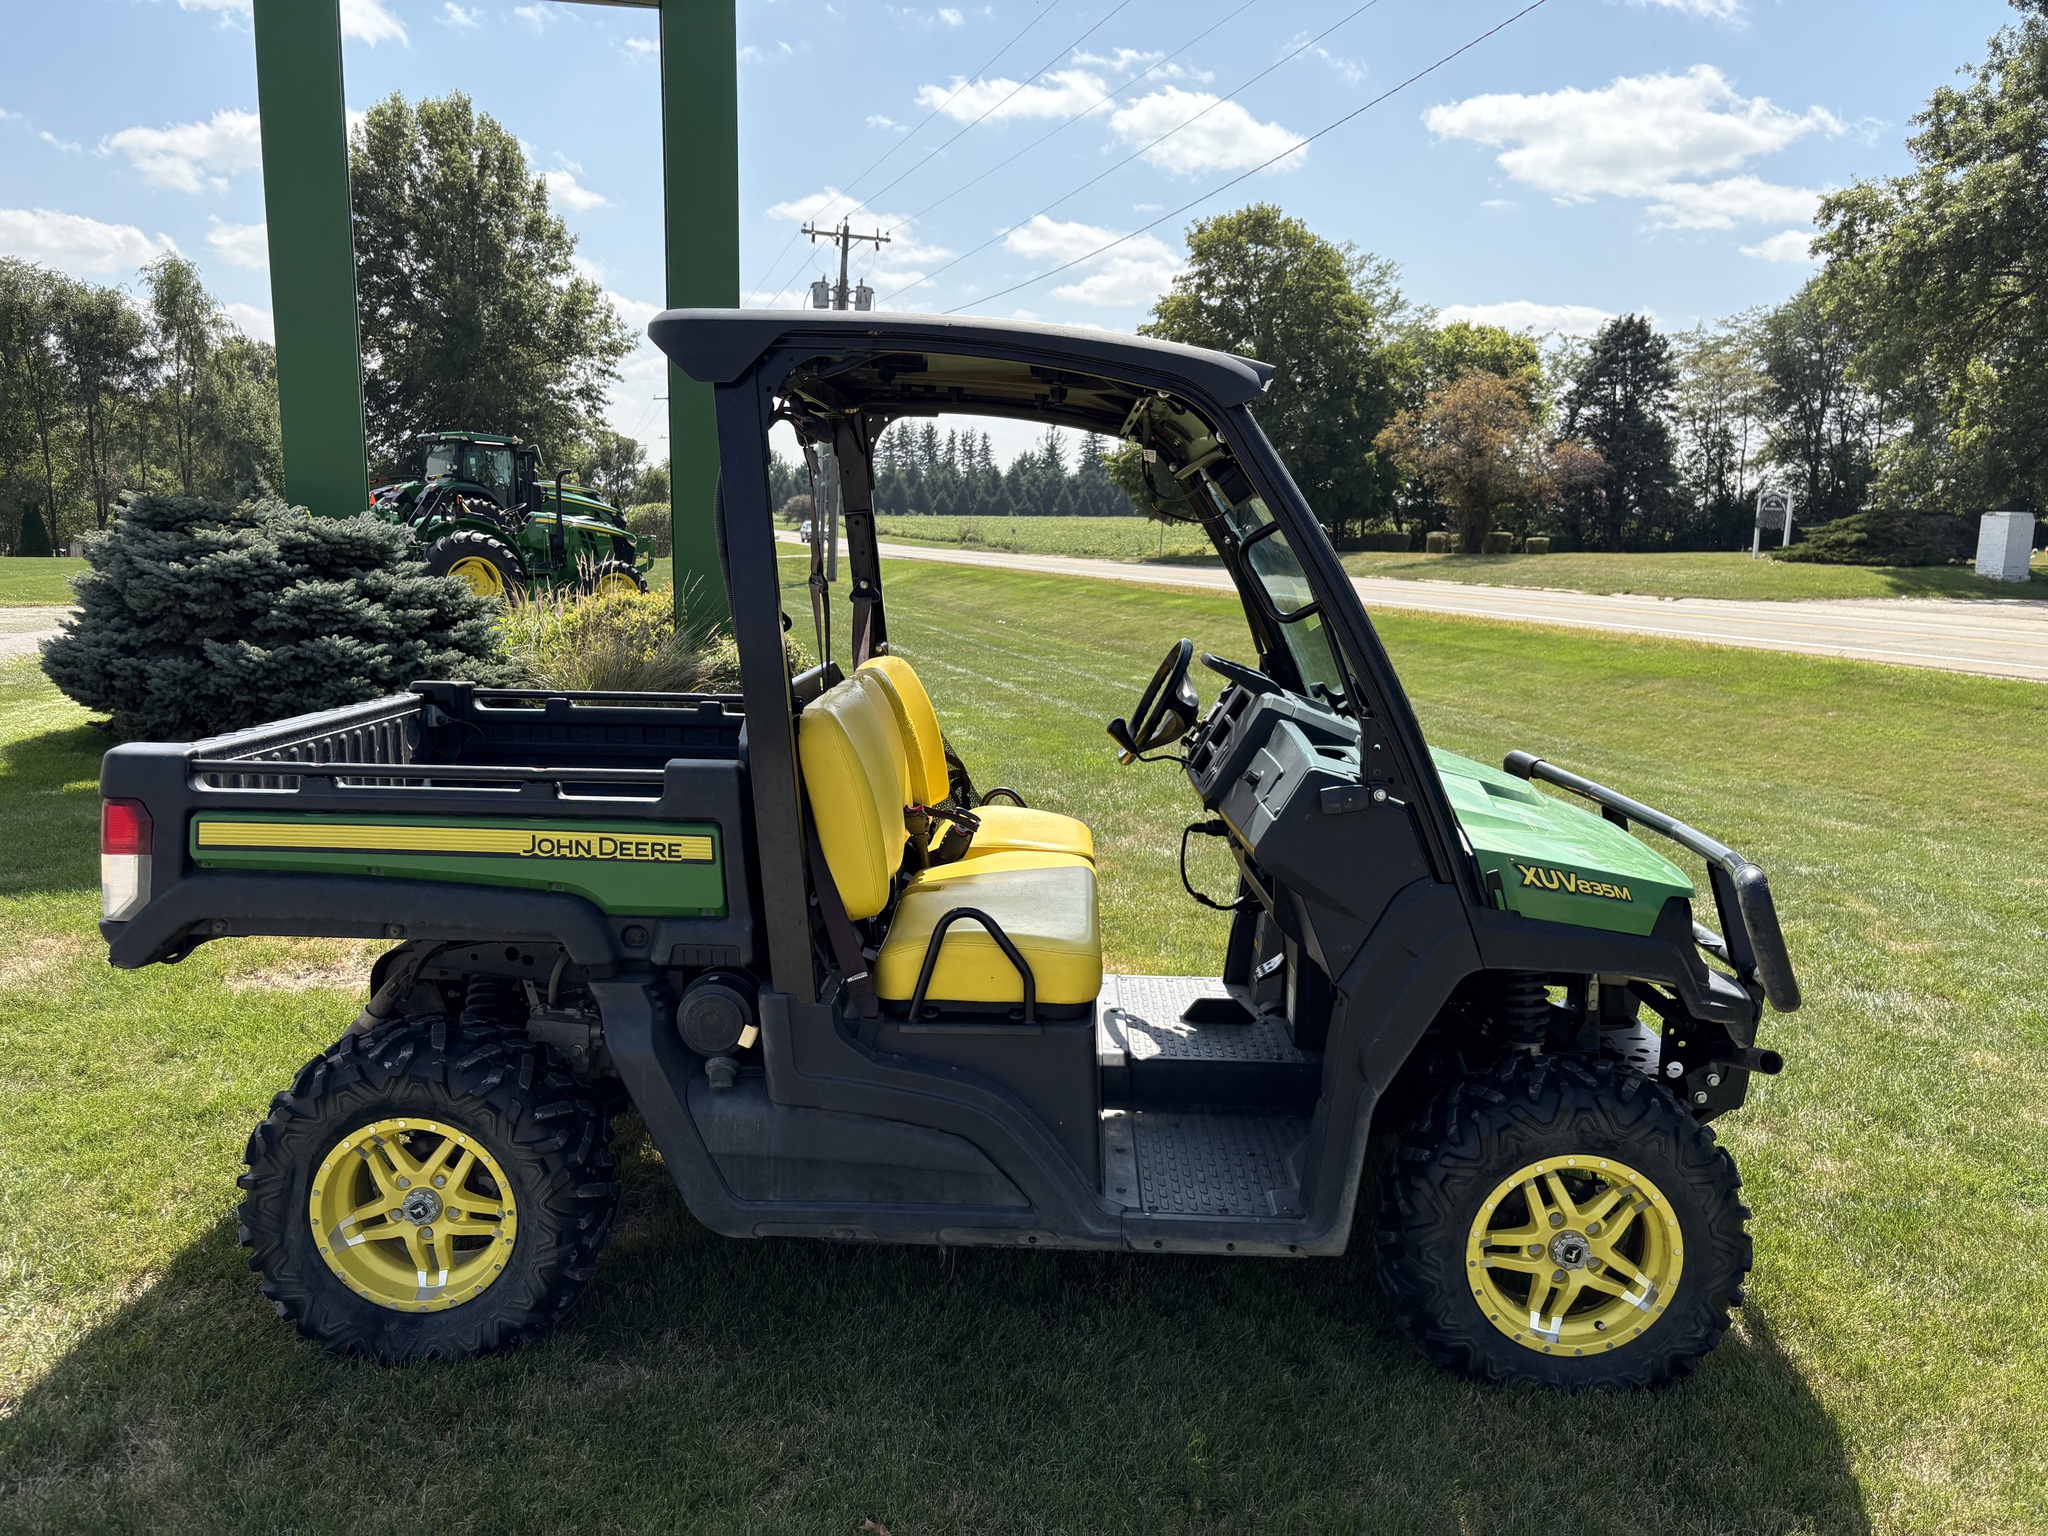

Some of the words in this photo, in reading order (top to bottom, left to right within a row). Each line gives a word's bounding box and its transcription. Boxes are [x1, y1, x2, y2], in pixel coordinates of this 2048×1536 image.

[522, 834, 592, 855] JOHN
[599, 837, 683, 859] DEERE
[1516, 863, 1633, 902] XUV835M
